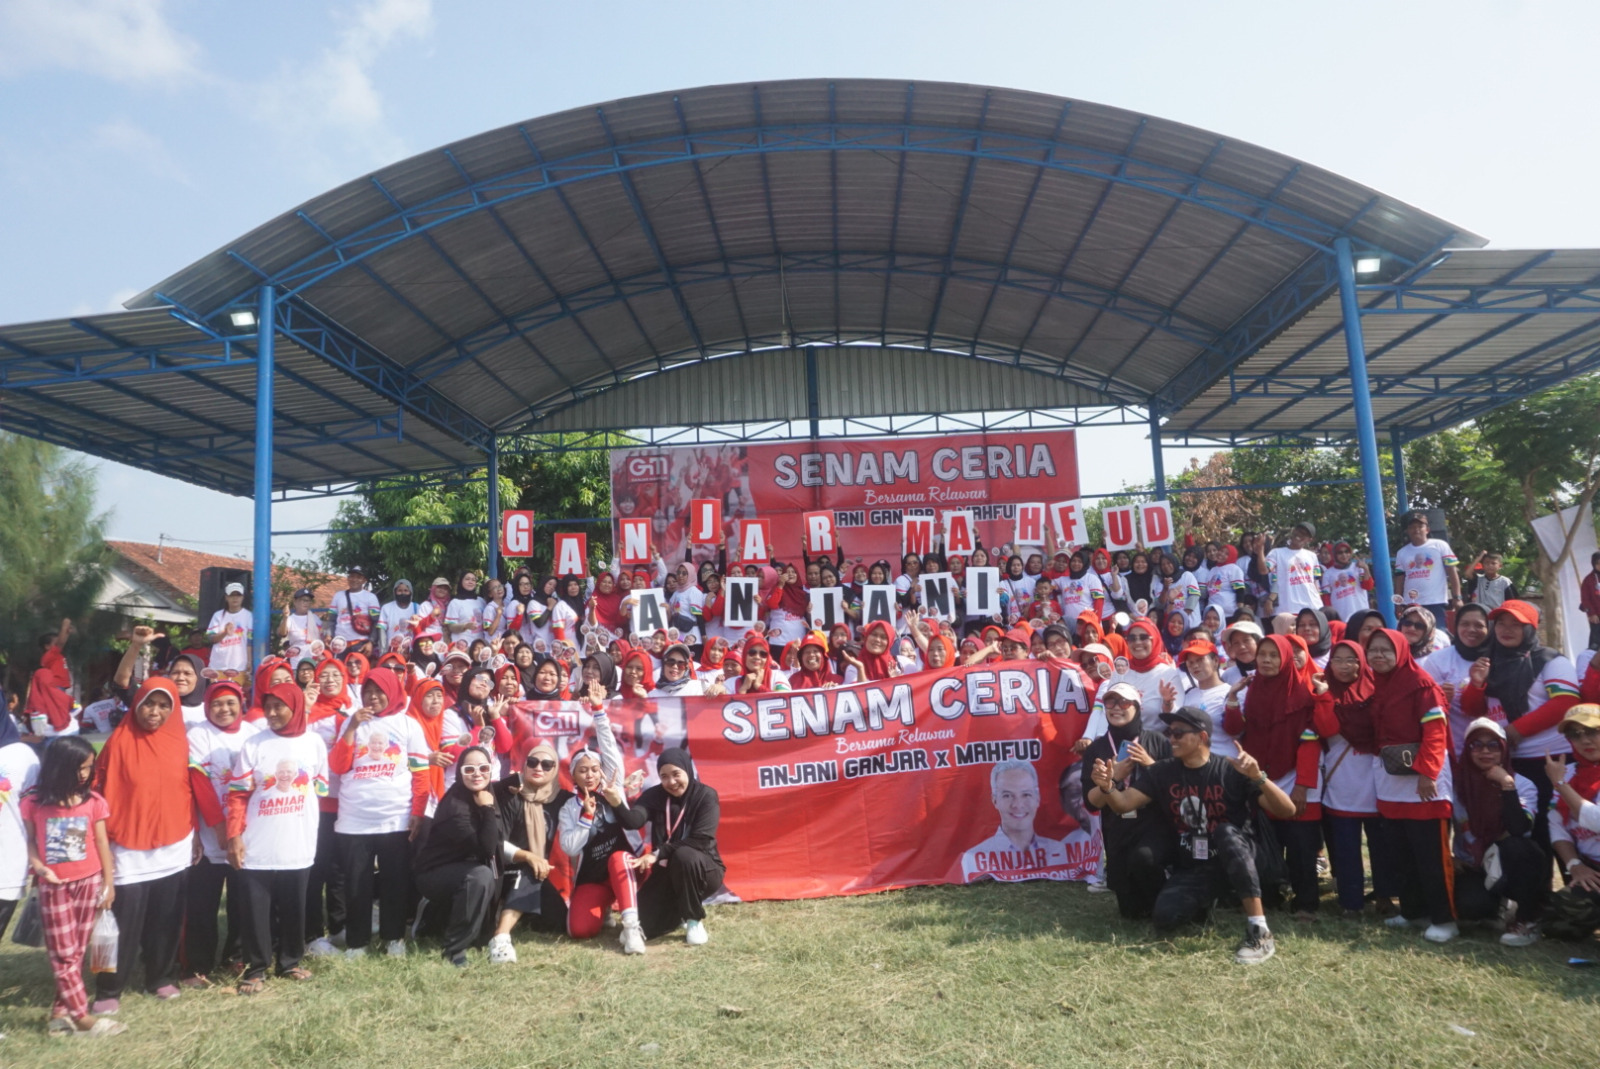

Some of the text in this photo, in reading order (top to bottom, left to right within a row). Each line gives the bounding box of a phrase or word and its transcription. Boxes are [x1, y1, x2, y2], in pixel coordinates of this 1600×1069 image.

[774, 443, 1056, 489] SENAM CERIA
[864, 486, 988, 506] Bersama Relawan
[957, 503, 1017, 521] AHFU
[506, 503, 1169, 575] G A N J A R M A H F U D
[640, 593, 665, 631] A
[729, 582, 754, 621] N
[867, 590, 892, 625] A
[924, 577, 950, 617] N
[722, 668, 1089, 745] SENAM CERIA
[835, 728, 956, 754] Bersama Relawan
[759, 758, 838, 789] ANJANI
[845, 748, 929, 779] GANJAR
[955, 738, 1042, 766] MAHFUD
[259, 795, 305, 809] GANJAR
[974, 847, 1047, 872] GANJAR
